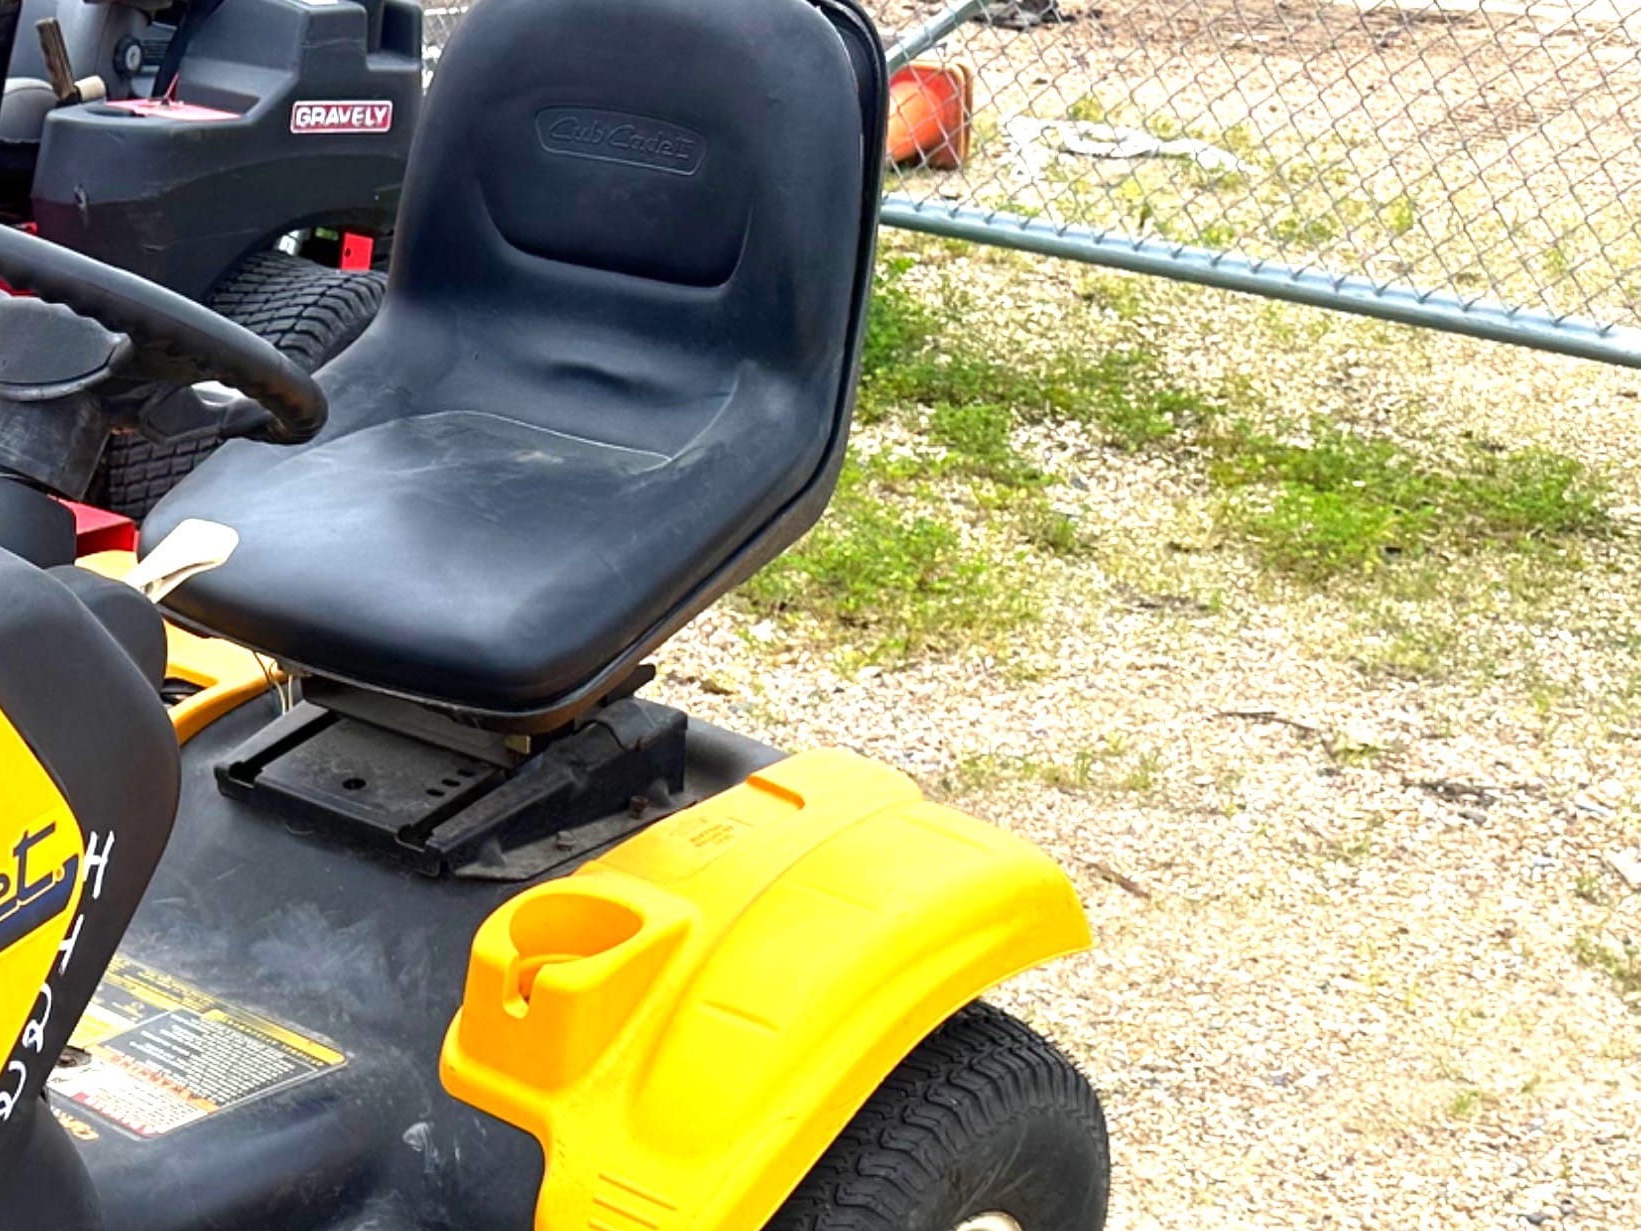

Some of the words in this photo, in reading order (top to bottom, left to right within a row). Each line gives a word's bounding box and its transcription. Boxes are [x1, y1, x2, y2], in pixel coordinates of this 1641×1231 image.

[295, 105, 388, 128] GRAVELY
[548, 116, 604, 144] Cub
[608, 124, 695, 160] Cadet
